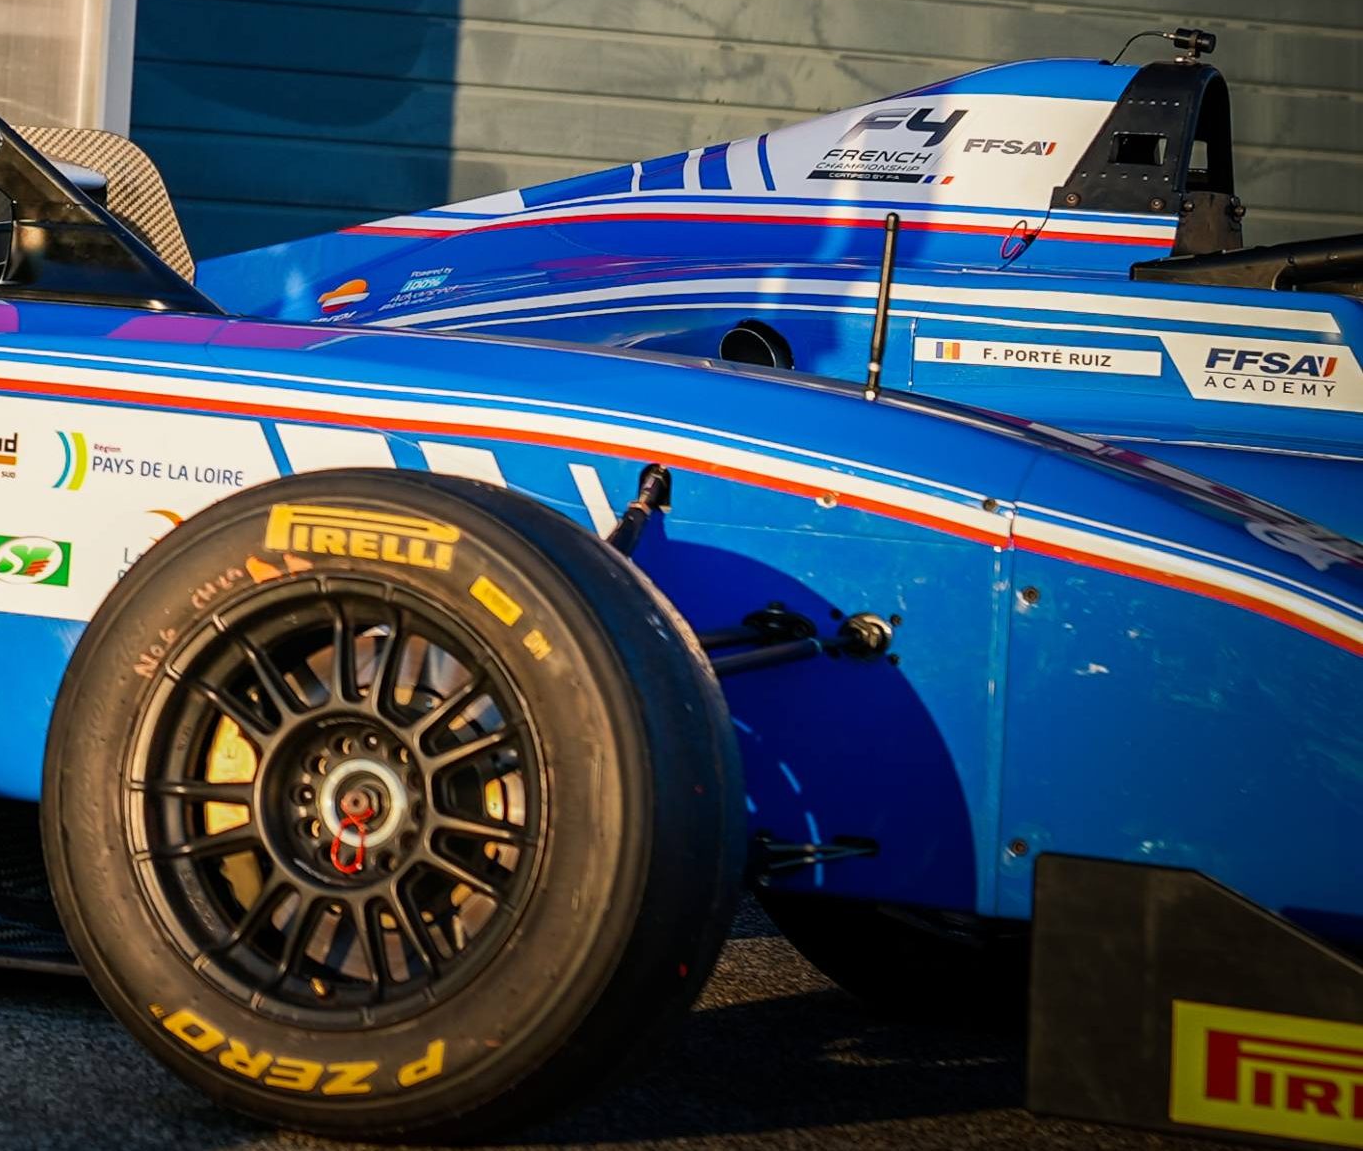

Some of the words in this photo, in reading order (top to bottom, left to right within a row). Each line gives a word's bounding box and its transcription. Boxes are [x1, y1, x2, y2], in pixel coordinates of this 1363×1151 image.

[836, 107, 968, 148] F4
[823, 148, 933, 164] FRENCH
[963, 138, 1044, 155] FFSA
[815, 161, 921, 172] CHAMPIONSHIP
[983, 348, 997, 360] F.
[1004, 348, 1062, 365] PORTÉ
[1069, 353, 1112, 367] RUIZ
[1205, 348, 1324, 377] FFSA
[1204, 376, 1336, 398] ACADEMY
[92, 456, 134, 475] PAYS
[140, 460, 162, 478] DE
[168, 464, 188, 481] LA
[195, 466, 244, 487] LOIRE
[264, 503, 460, 571] PIRELLI
[163, 1009, 379, 1095] ZERO
[397, 1039, 446, 1088] P
